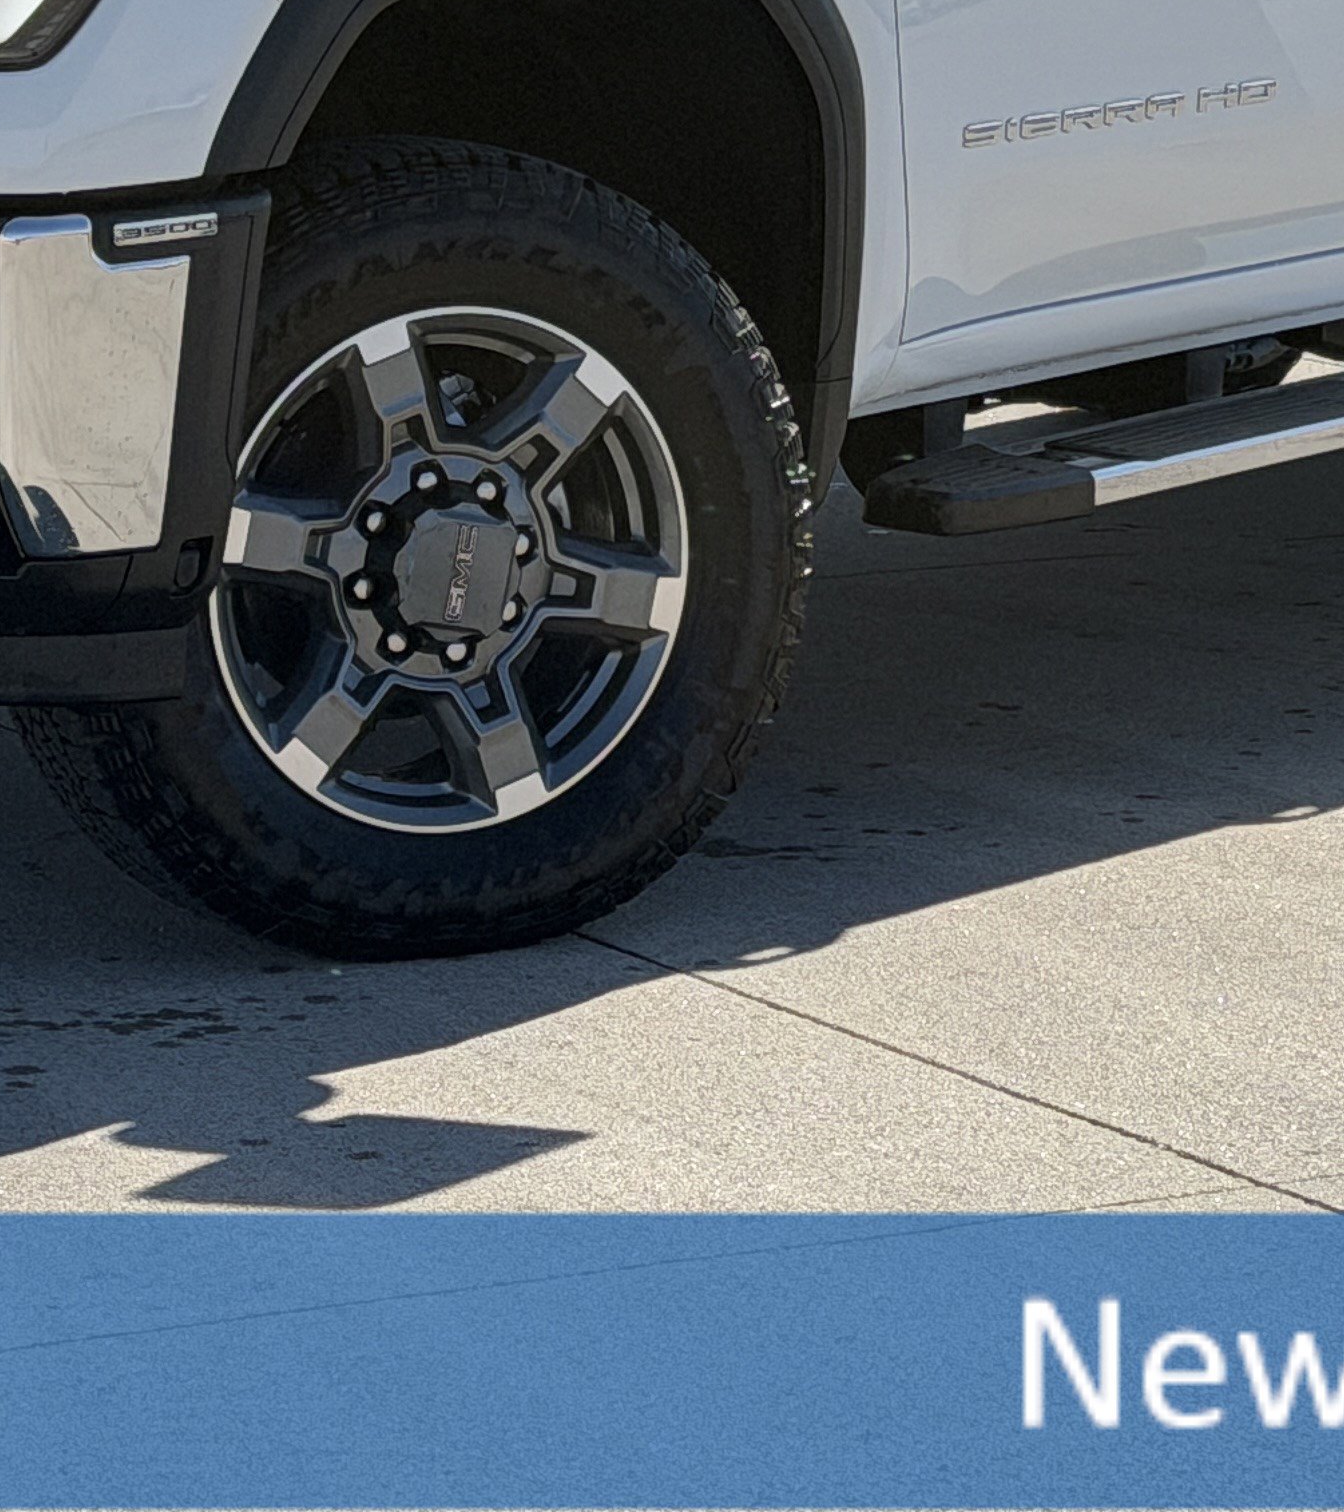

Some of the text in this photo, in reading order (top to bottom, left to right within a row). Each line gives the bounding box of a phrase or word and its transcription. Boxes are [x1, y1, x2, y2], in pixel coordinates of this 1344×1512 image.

[961, 78, 1278, 149] SIERRA HD
[120, 219, 213, 240] 3500
[443, 524, 479, 624] GMC
